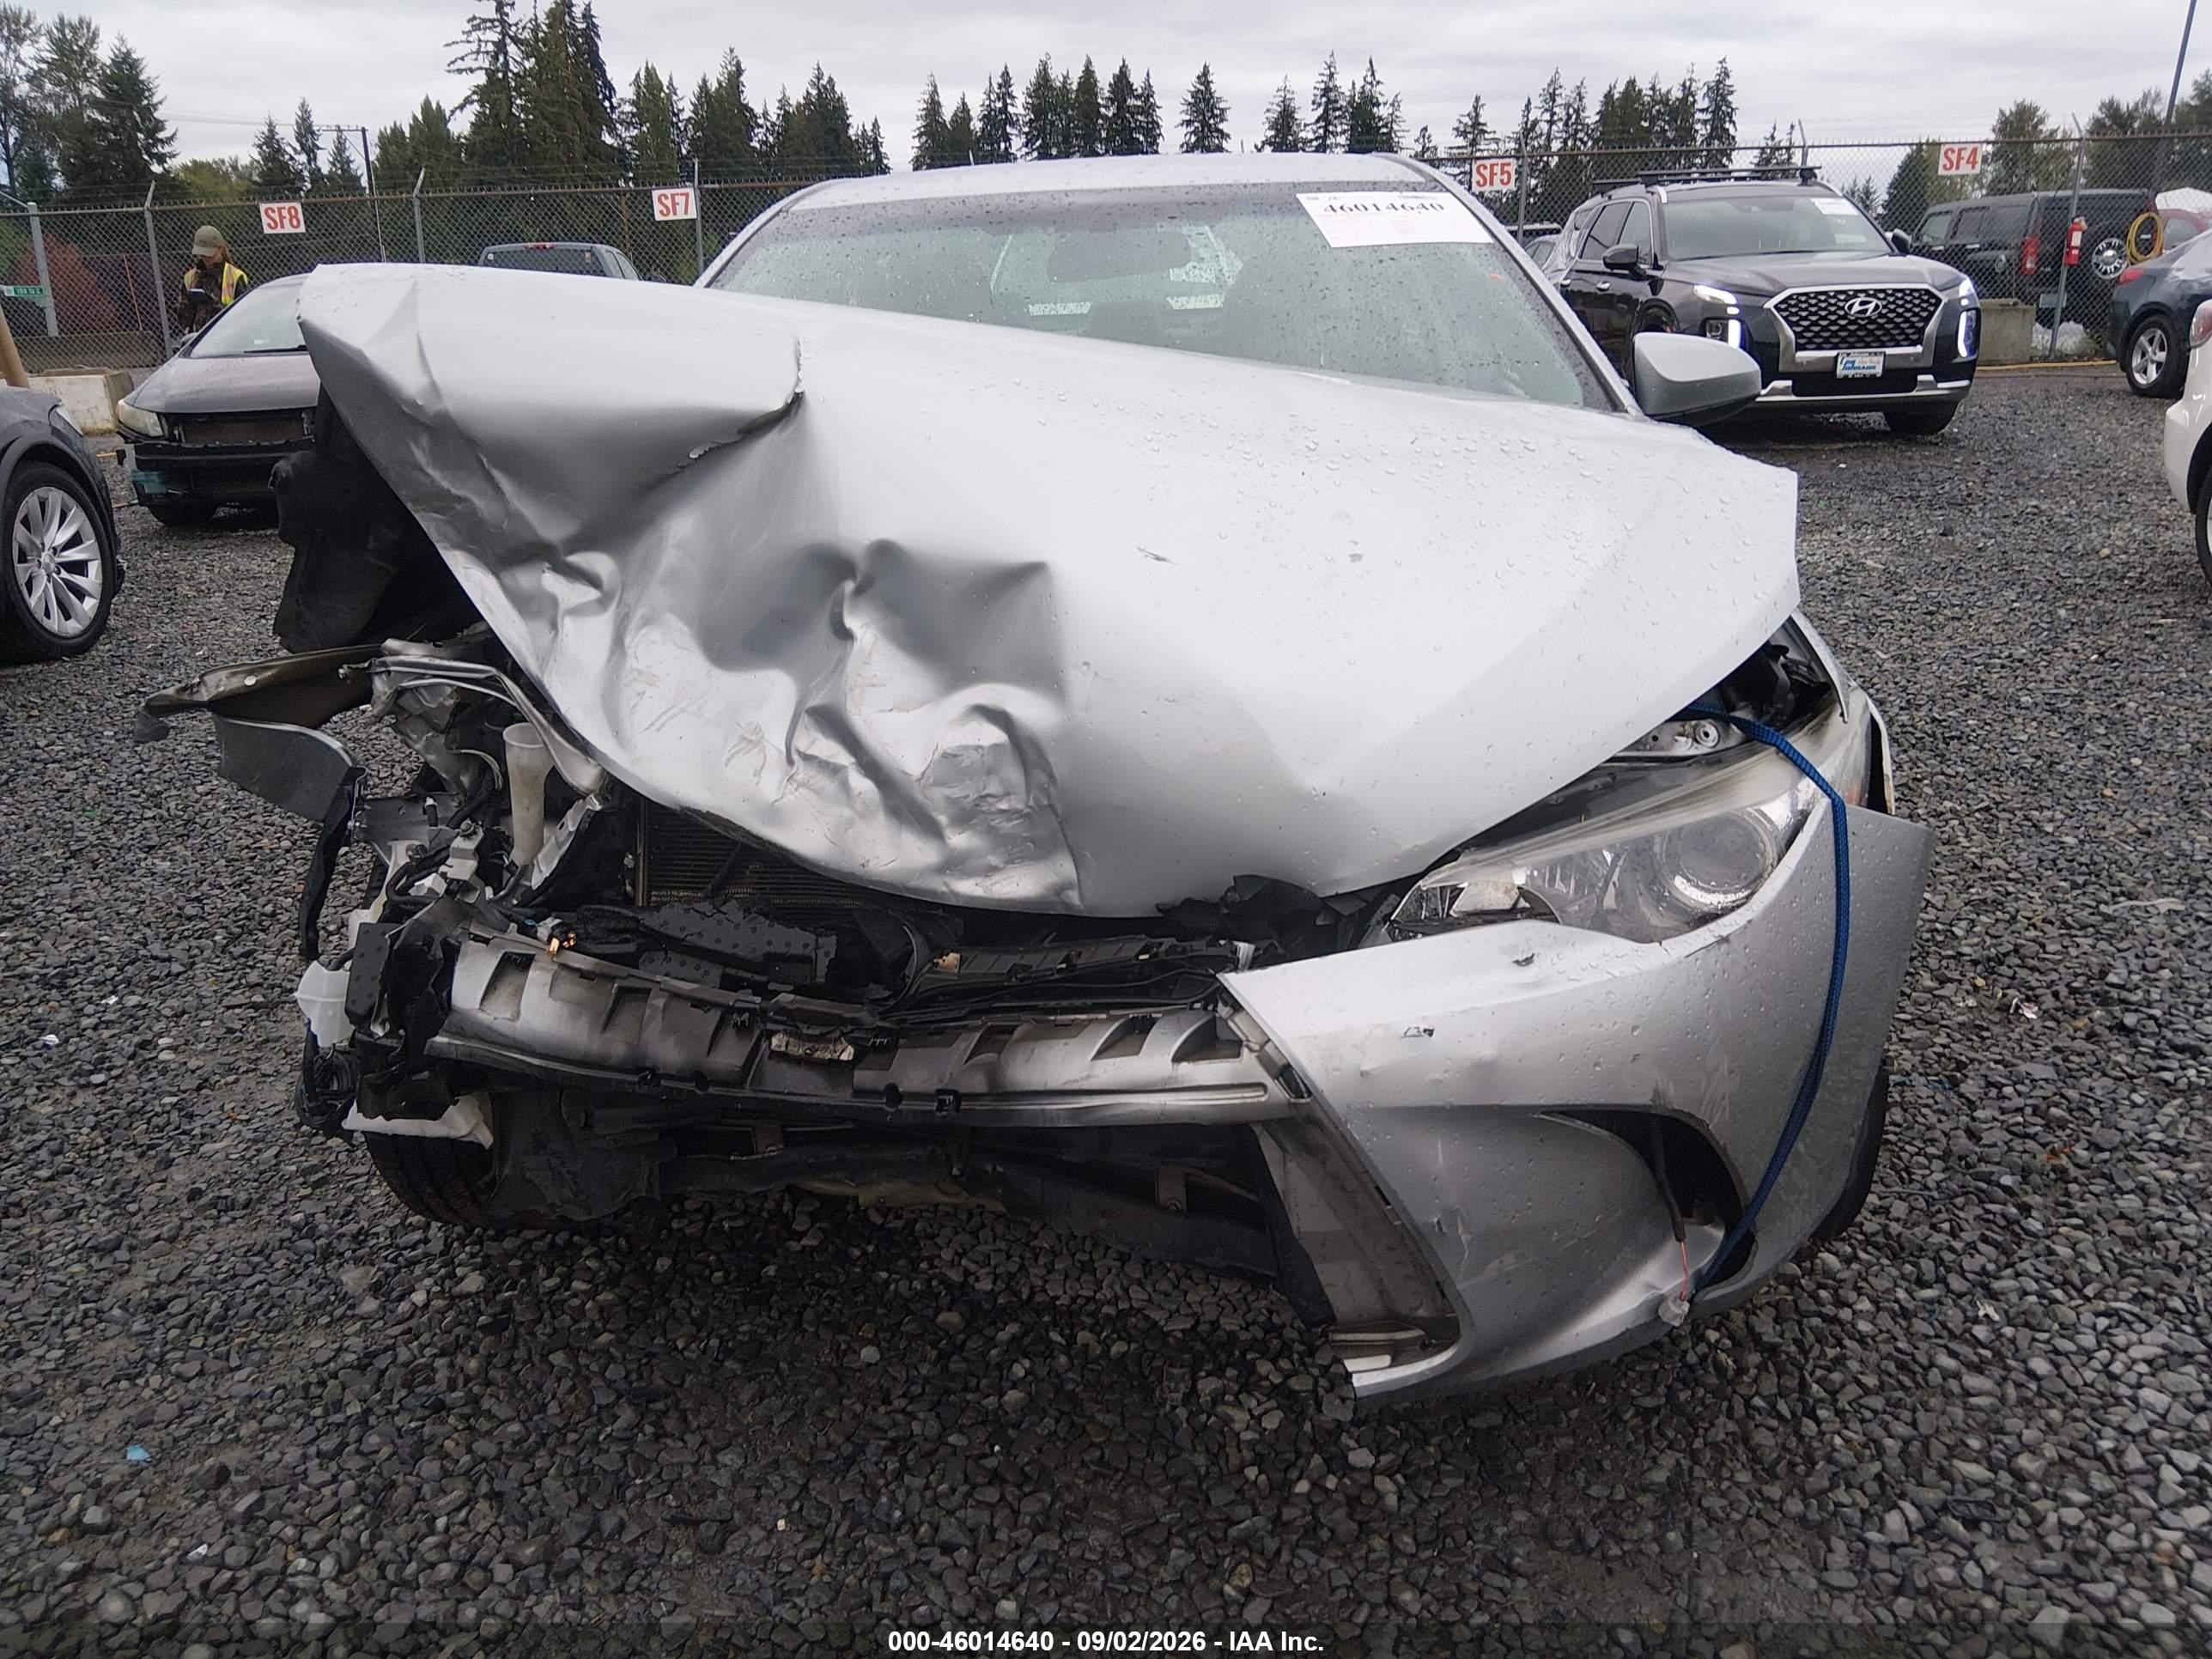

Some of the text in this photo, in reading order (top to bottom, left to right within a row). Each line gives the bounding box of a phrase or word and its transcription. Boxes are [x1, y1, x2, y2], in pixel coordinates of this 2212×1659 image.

[1942, 147, 1978, 171] SF4
[1475, 162, 1512, 187] SF5
[657, 191, 690, 216] SF7
[1323, 202, 1445, 214] 46014640
[264, 205, 301, 230] SF8
